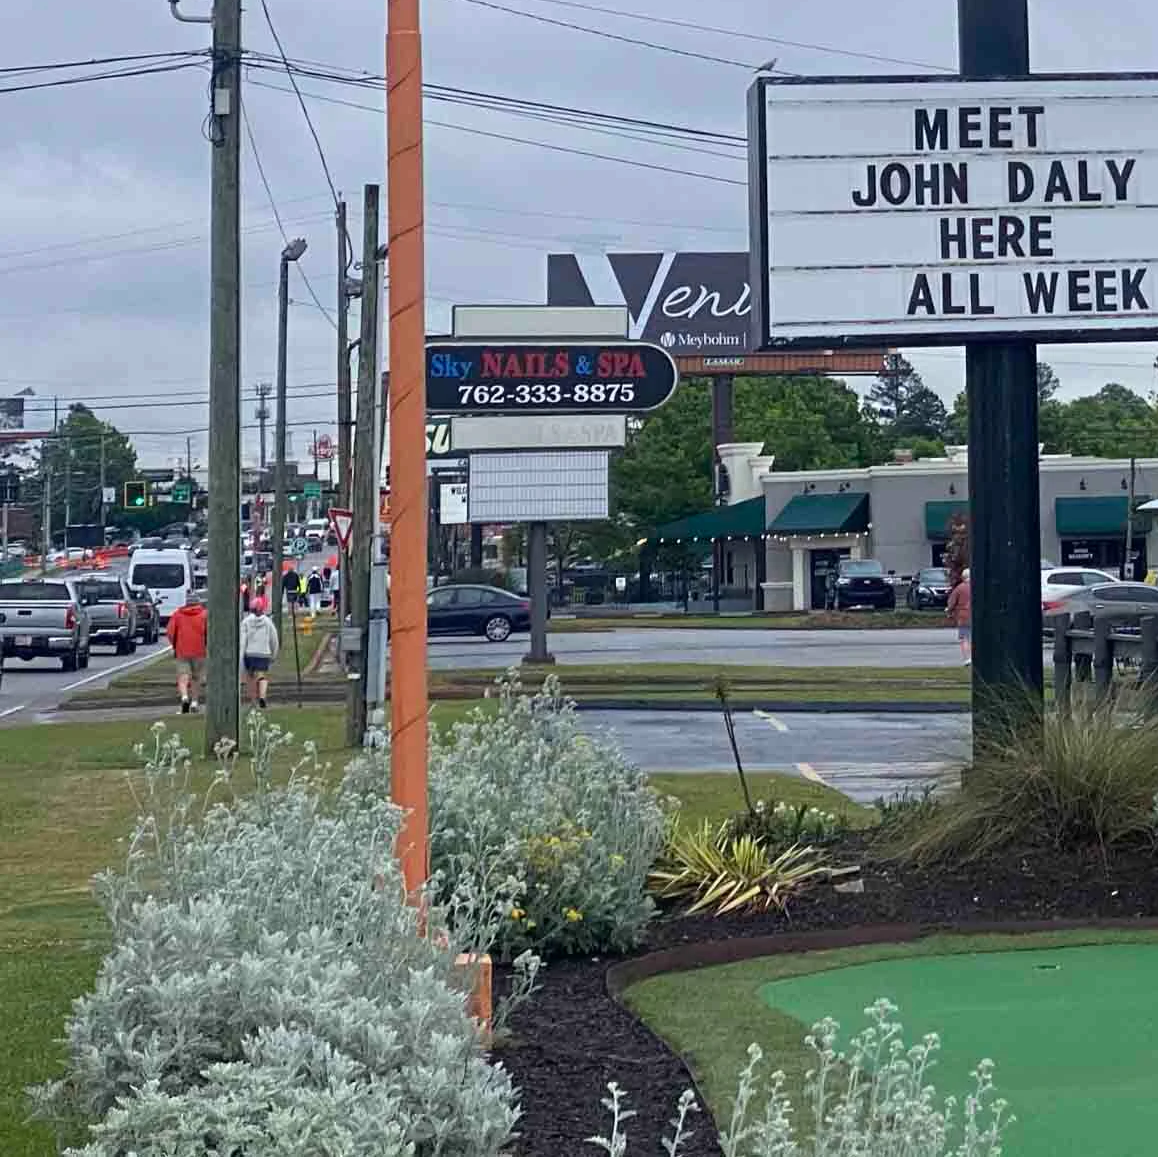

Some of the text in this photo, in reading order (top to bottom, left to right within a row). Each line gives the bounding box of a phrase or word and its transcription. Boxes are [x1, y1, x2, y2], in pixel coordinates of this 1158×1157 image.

[913, 105, 1046, 152] MEET
[851, 158, 1137, 208] JOHN DALY
[939, 214, 1055, 260] HERE
[906, 267, 1150, 316] ALL WEEK
[678, 332, 739, 348] Meybohm
[430, 351, 647, 381] Sky NAILS & SPA
[457, 383, 635, 404] 762-333-8875
